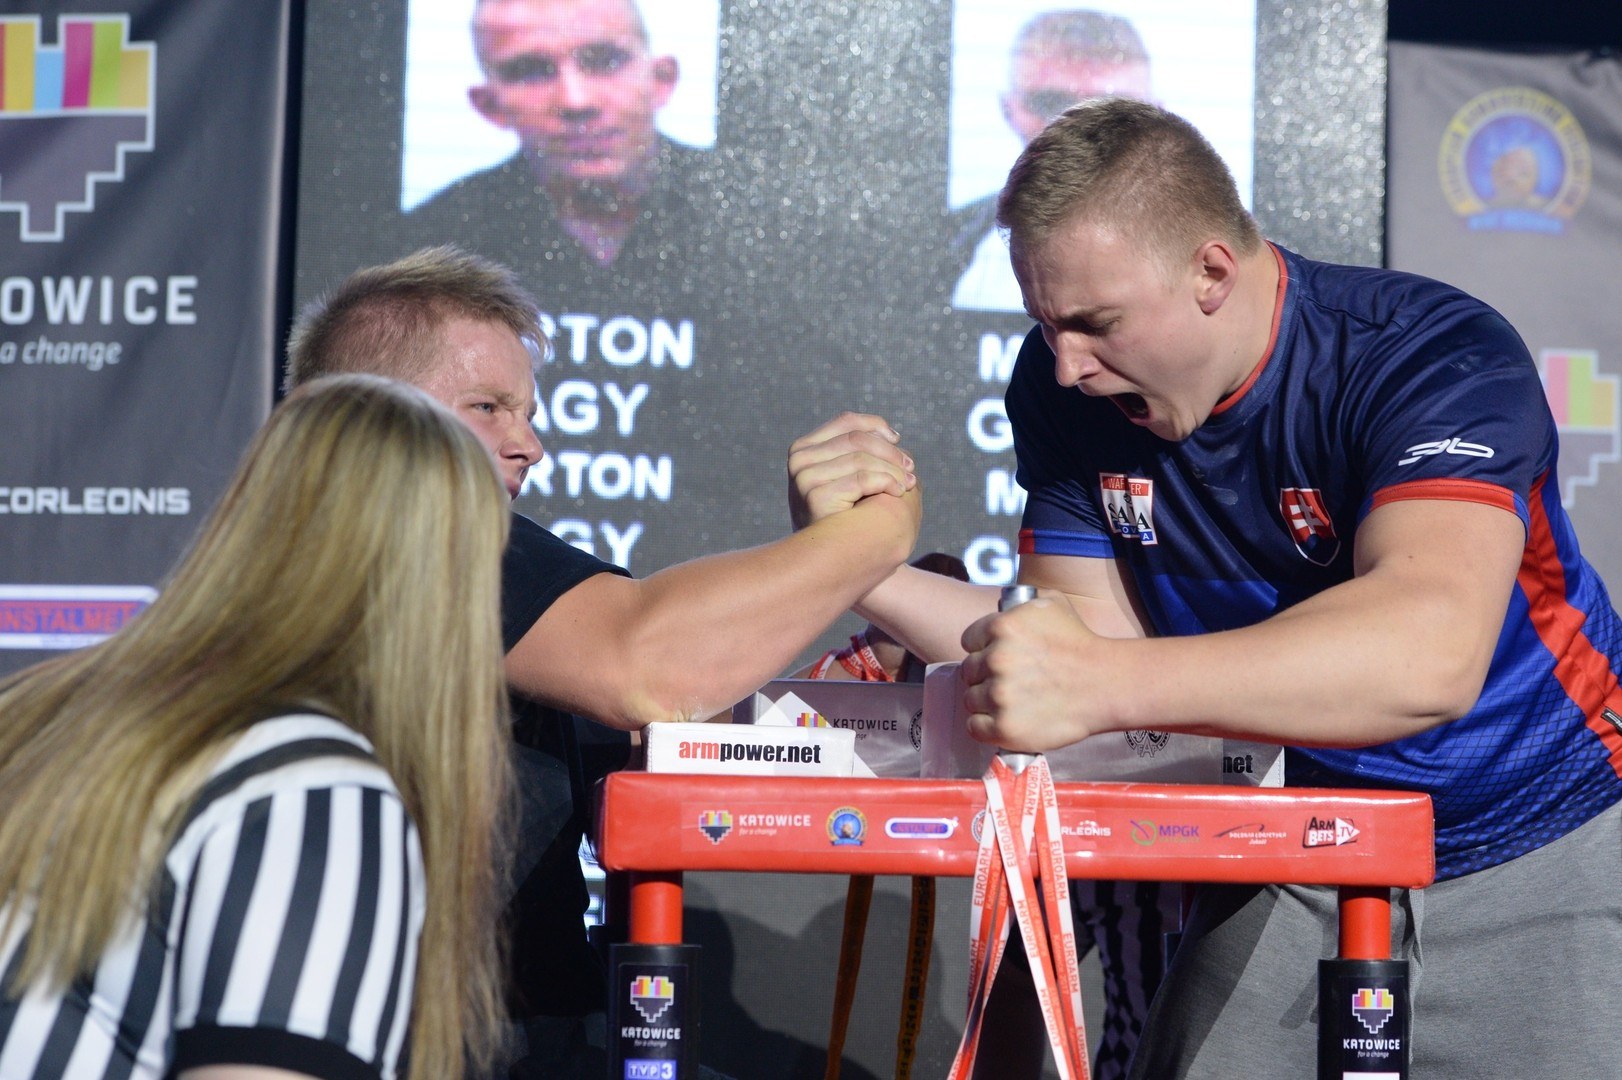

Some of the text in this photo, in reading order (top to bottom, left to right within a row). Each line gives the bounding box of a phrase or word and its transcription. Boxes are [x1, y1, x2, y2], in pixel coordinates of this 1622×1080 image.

[0, 275, 198, 325] OWICE
[22, 334, 123, 371] change
[833, 718, 898, 731] KATOWICE
[678, 740, 822, 764] armpower.net
[1024, 765, 1039, 816] EUROARM
[738, 814, 811, 827] KATOWICE
[996, 808, 1018, 868] EUROARM
[1159, 825, 1200, 837] MPGK
[1308, 830, 1334, 846] BETS
[974, 847, 990, 907] EUROARM
[1050, 840, 1067, 900] EUROARM
[1017, 899, 1040, 958] EUROARM
[1063, 932, 1079, 993] EUROARM
[622, 1027, 680, 1039] KATOWICE
[1343, 1039, 1400, 1050] KATOWICE
